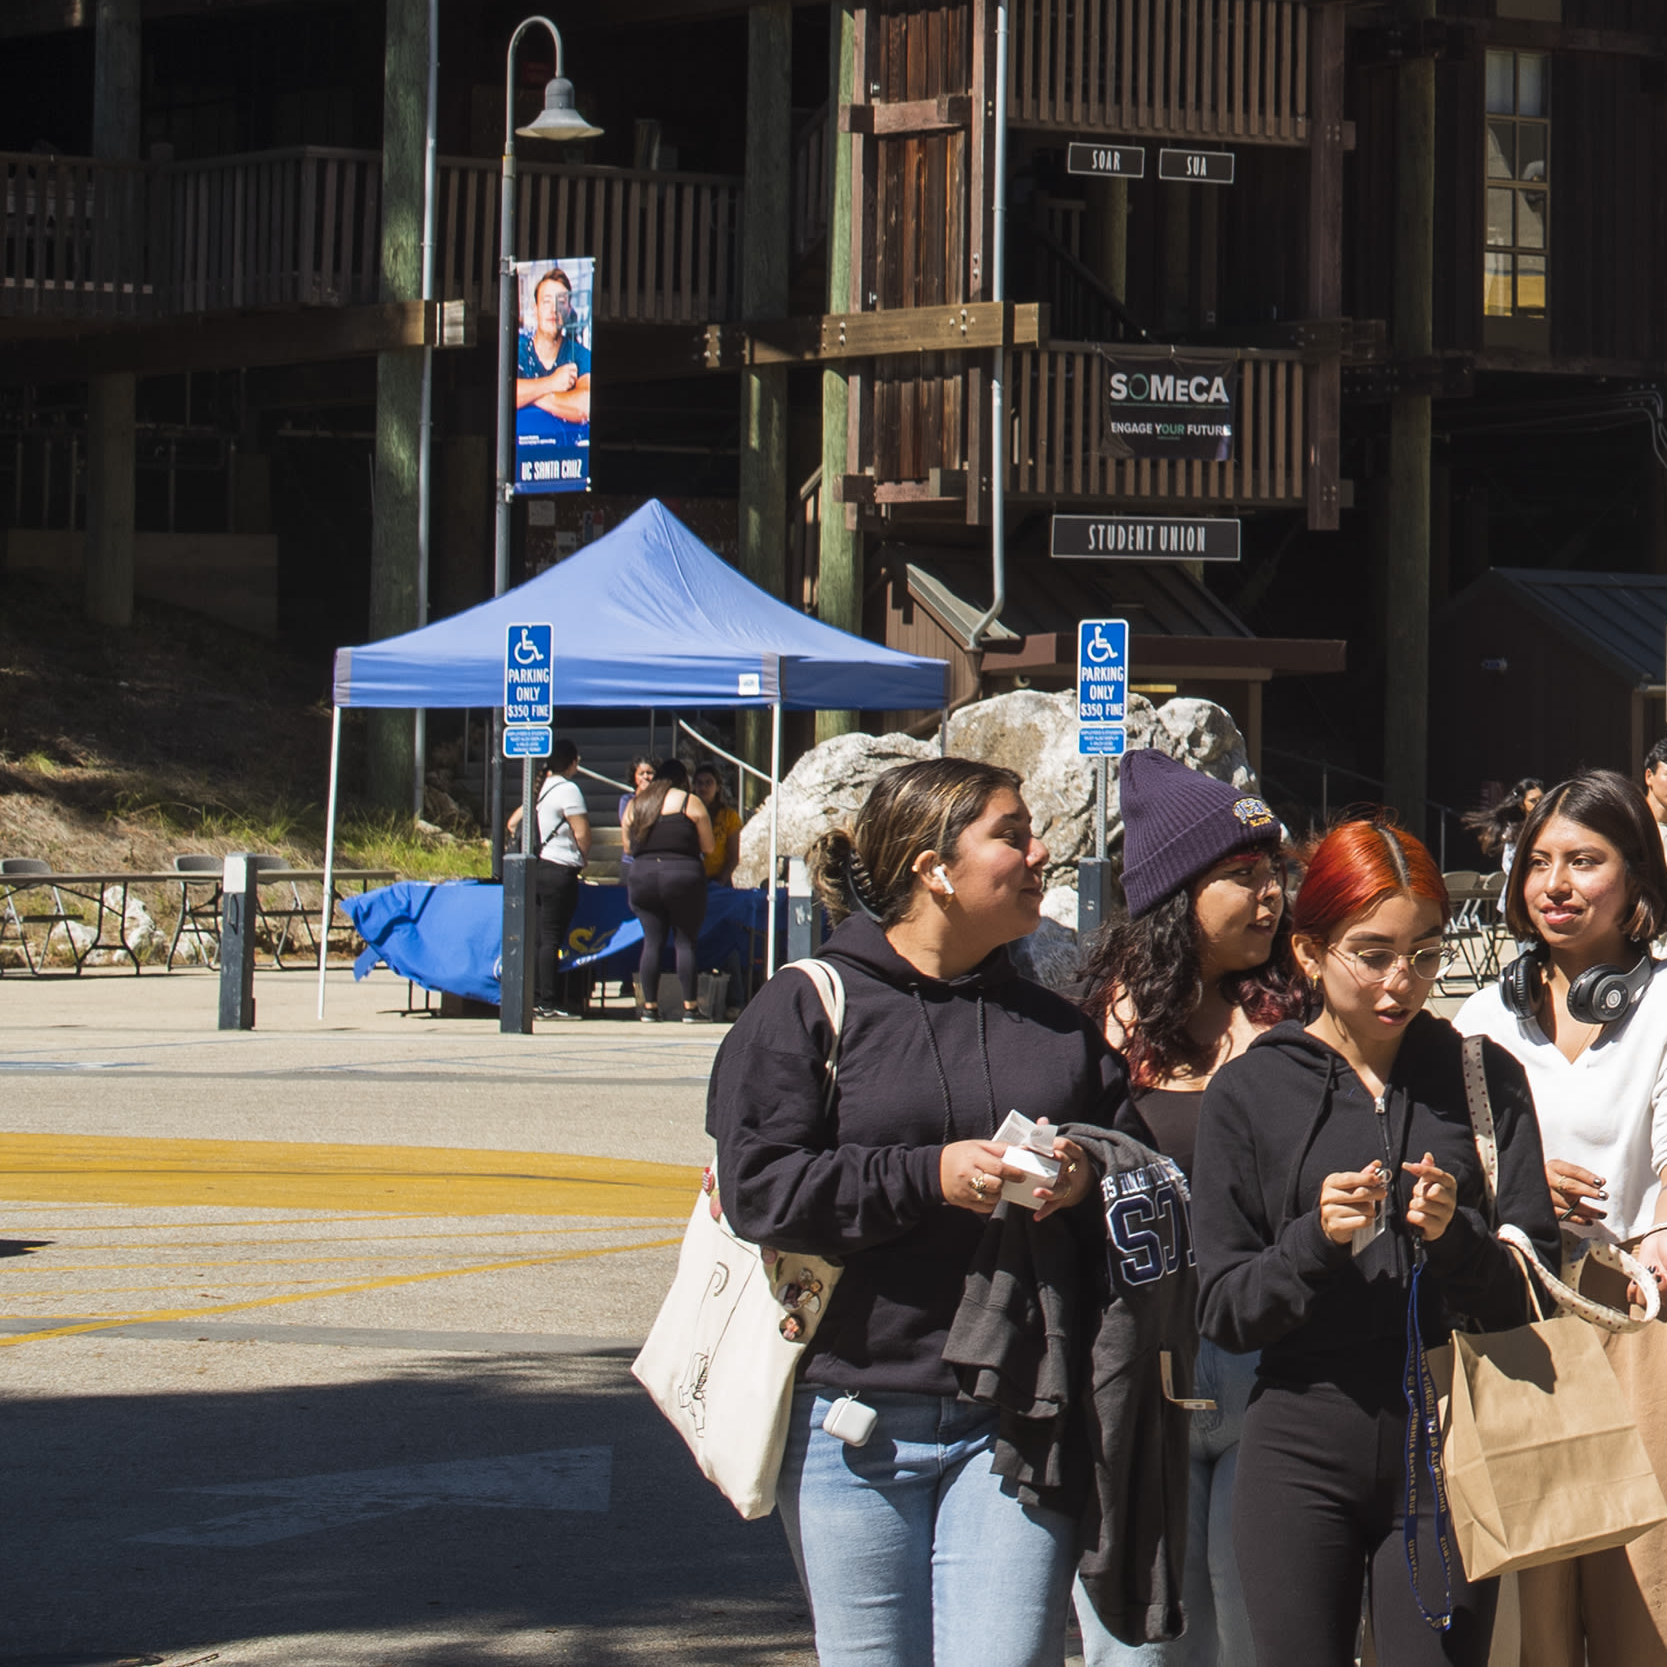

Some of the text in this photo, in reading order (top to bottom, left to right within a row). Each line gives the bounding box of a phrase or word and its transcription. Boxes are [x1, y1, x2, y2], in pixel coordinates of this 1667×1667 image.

[1092, 149, 1121, 171] SOAR
[1186, 155, 1207, 177] SUA
[1110, 421, 1232, 437] ENGAGE YOUR FUTURE
[521, 458, 582, 481] UC SANTA CRUZ
[1088, 524, 1206, 552] STUDENT UNION
[508, 668, 550, 684] PARKING
[1081, 666, 1124, 682] PARKING
[516, 686, 540, 702] ONLY
[1089, 684, 1115, 701] ONLY
[507, 704, 549, 718] $350 FINE
[1080, 702, 1124, 717] $350 FINE
[1429, 1435, 1439, 1448] OF
[1408, 1488, 1418, 1517] CRUZ
